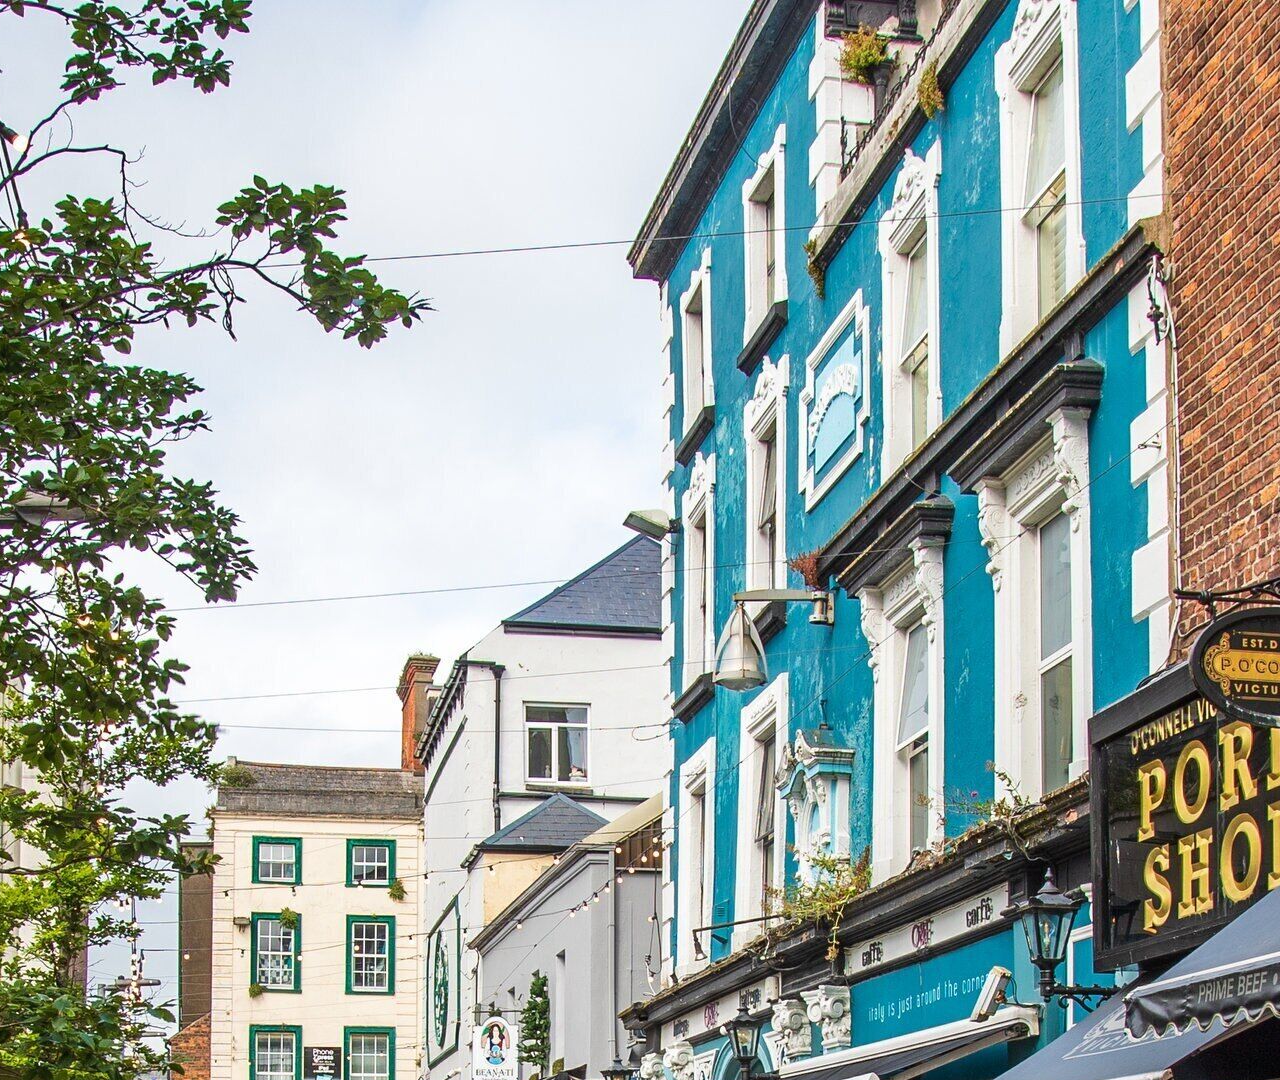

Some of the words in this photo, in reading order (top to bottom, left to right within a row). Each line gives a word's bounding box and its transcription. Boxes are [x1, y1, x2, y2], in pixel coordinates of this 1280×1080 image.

[1131, 708, 1194, 755] O'CONNELL
[888, 1001, 896, 1018] is
[897, 996, 914, 1019] just
[916, 987, 941, 1012] around
[943, 981, 959, 1002] the
[1198, 975, 1236, 1002] PRIME
[1238, 971, 1268, 995] BEEF
